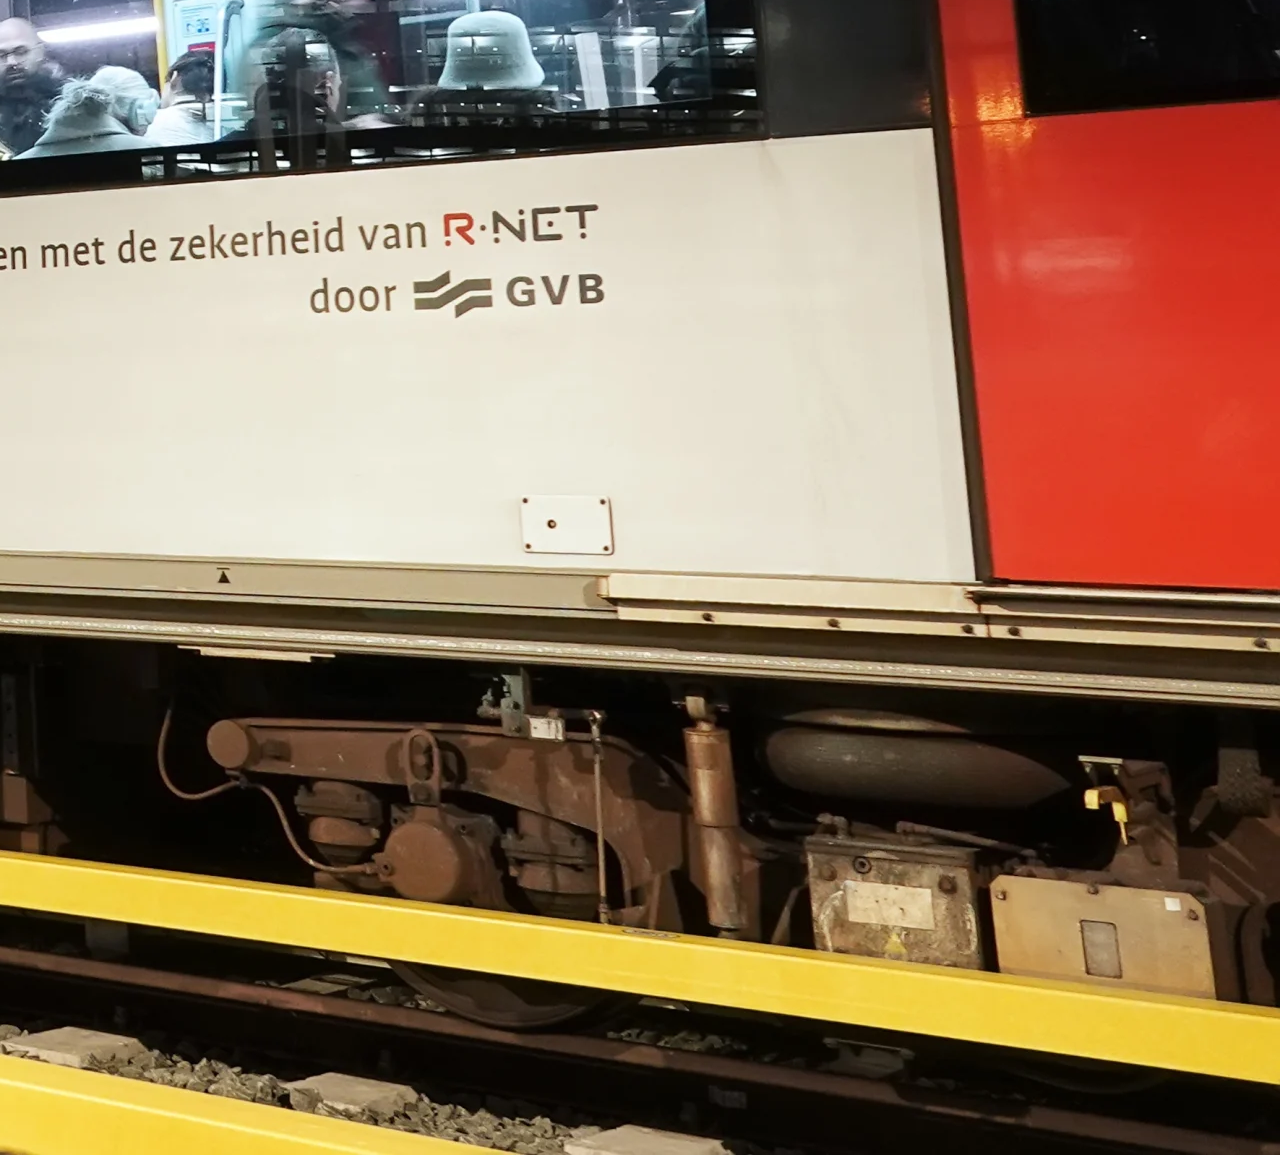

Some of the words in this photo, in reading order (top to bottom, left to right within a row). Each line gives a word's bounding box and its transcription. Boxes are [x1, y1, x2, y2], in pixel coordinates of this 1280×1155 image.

[40, 237, 106, 269] met
[117, 229, 158, 265] de
[168, 215, 344, 262] zekerheid
[358, 220, 427, 251] van
[309, 276, 397, 314] door
[505, 272, 606, 307] GVB
